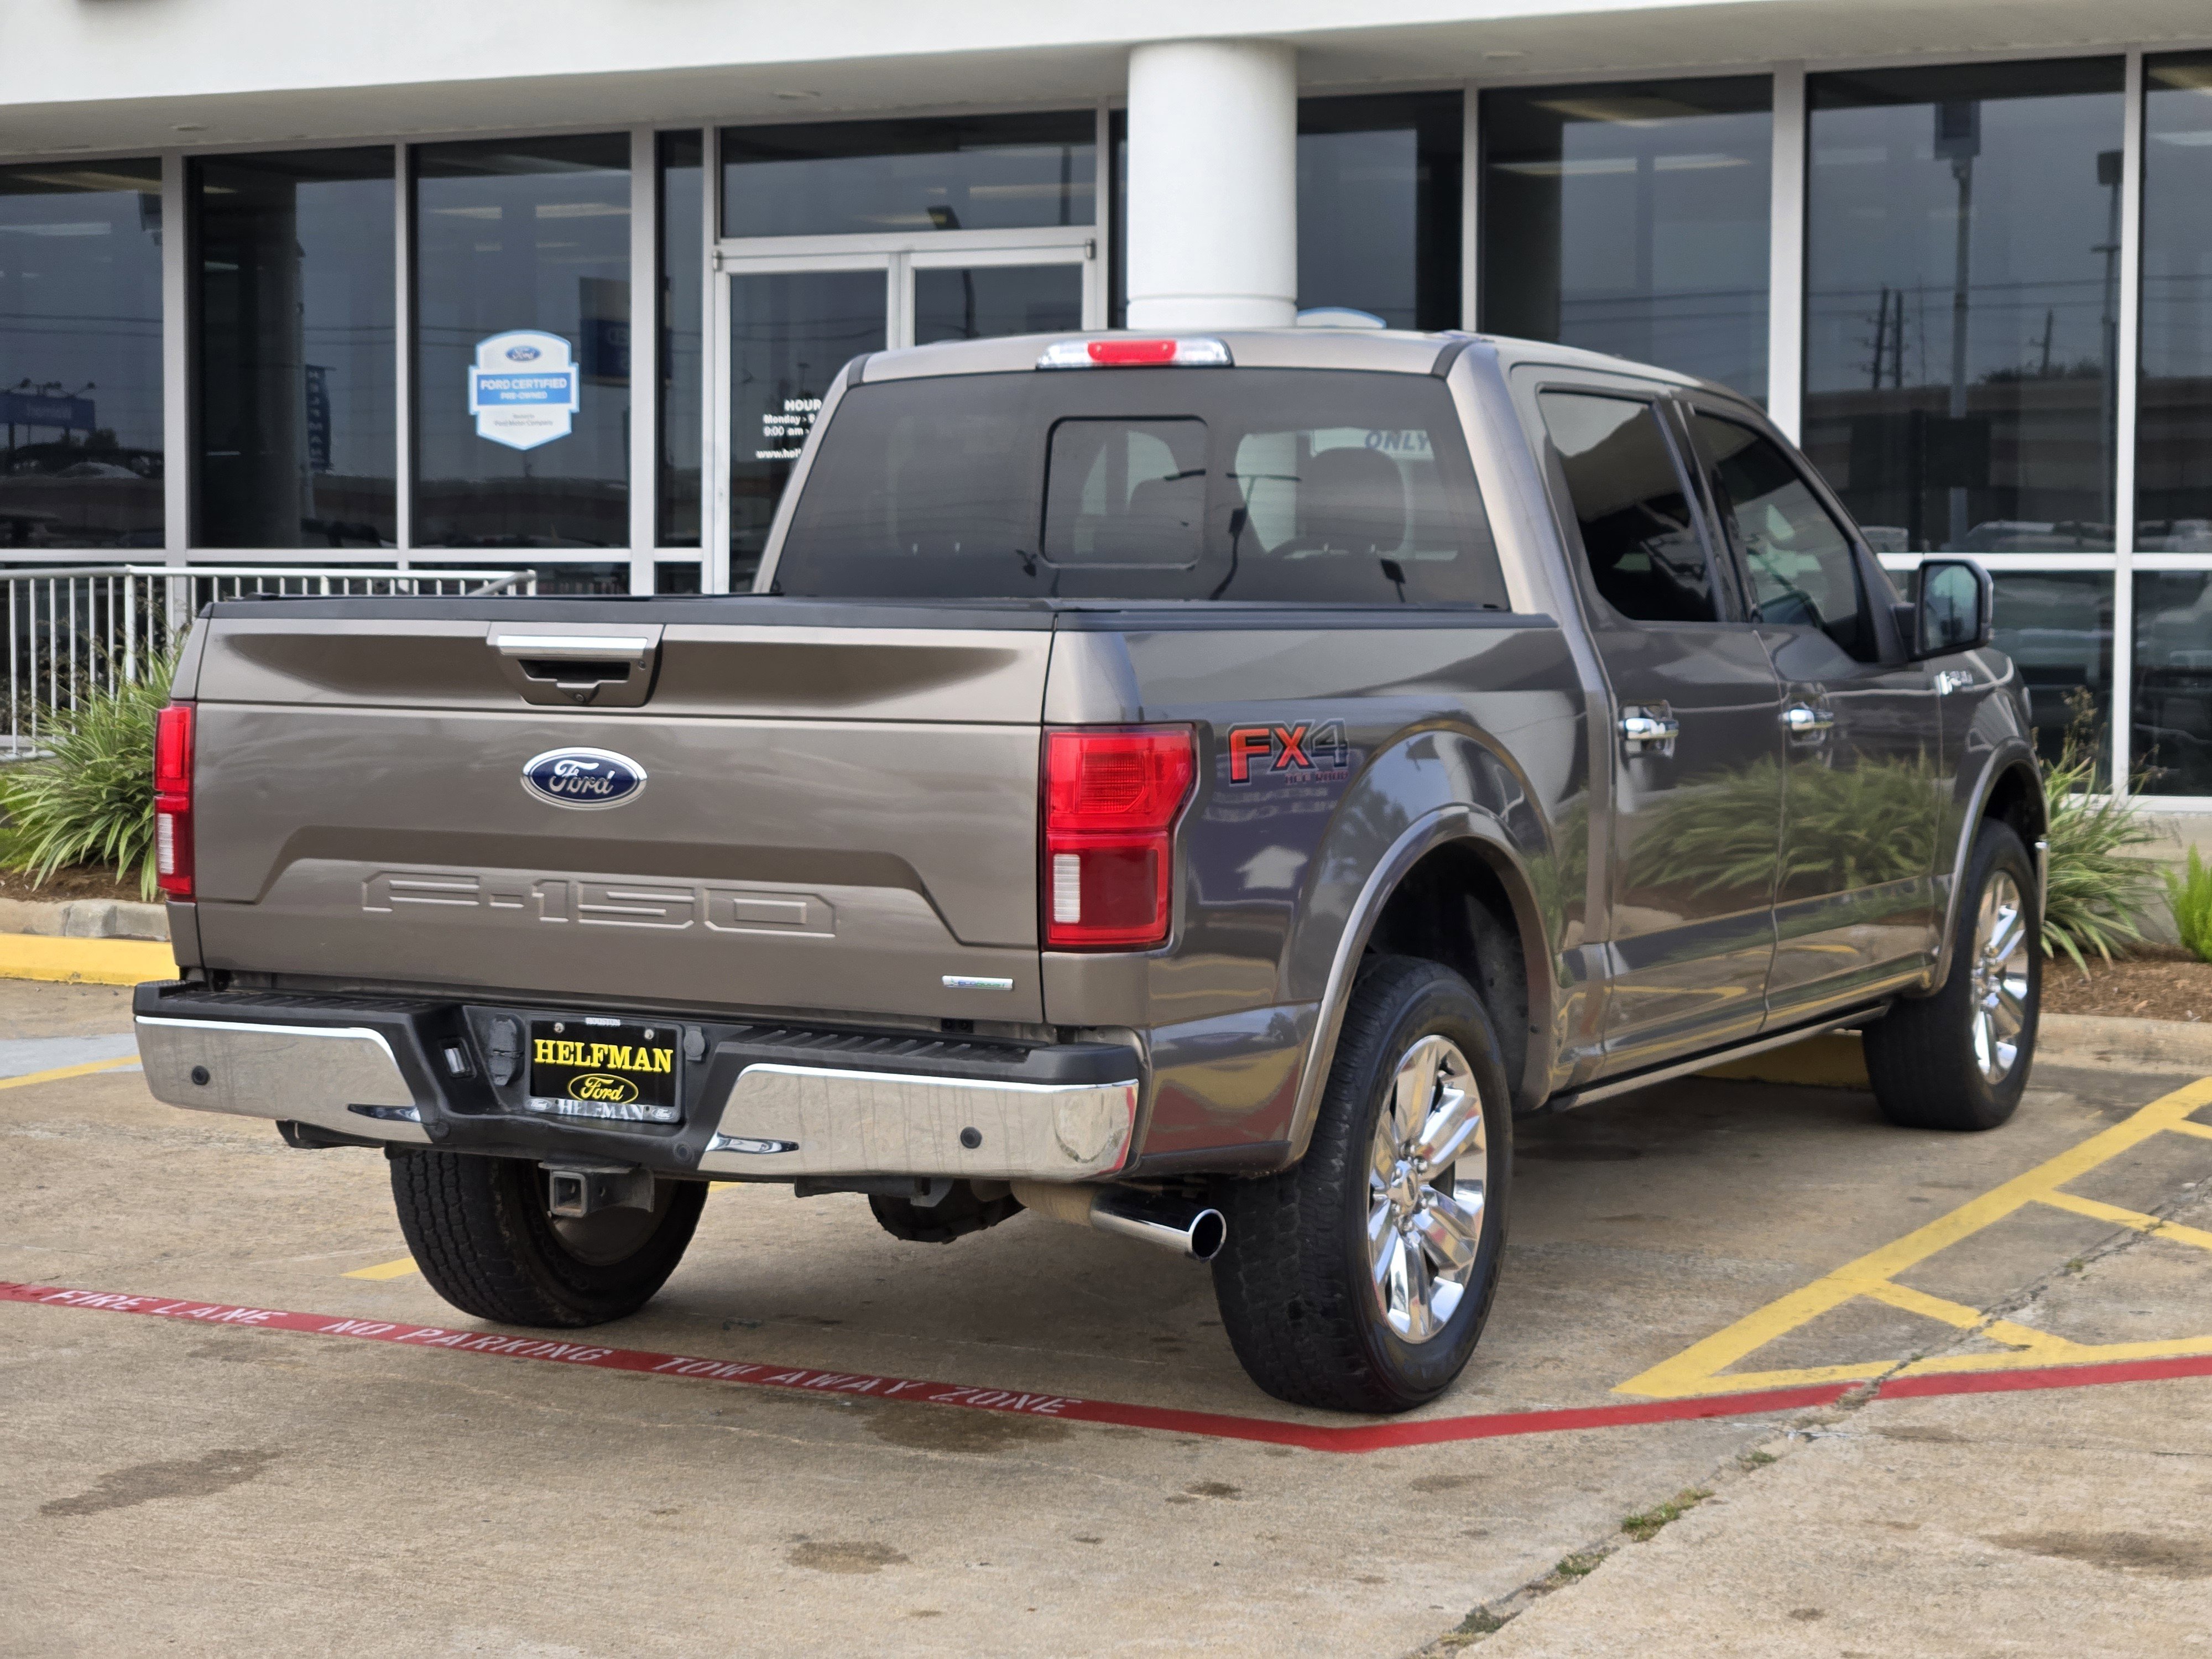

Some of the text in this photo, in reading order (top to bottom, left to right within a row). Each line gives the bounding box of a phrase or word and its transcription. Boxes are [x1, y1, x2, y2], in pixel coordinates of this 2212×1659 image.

[481, 378, 567, 390] FORD CERTIFIED
[763, 414, 801, 425] Monday
[786, 427, 804, 436] am
[1228, 718, 1349, 786] FX4
[549, 759, 615, 796] Ford
[362, 870, 837, 937] F-150
[534, 1039, 674, 1074] HELFMAN
[581, 1077, 625, 1102] Ford
[40, 1290, 1082, 1413] FIRE LANE NO PARKING TOW AWAY ZONE
